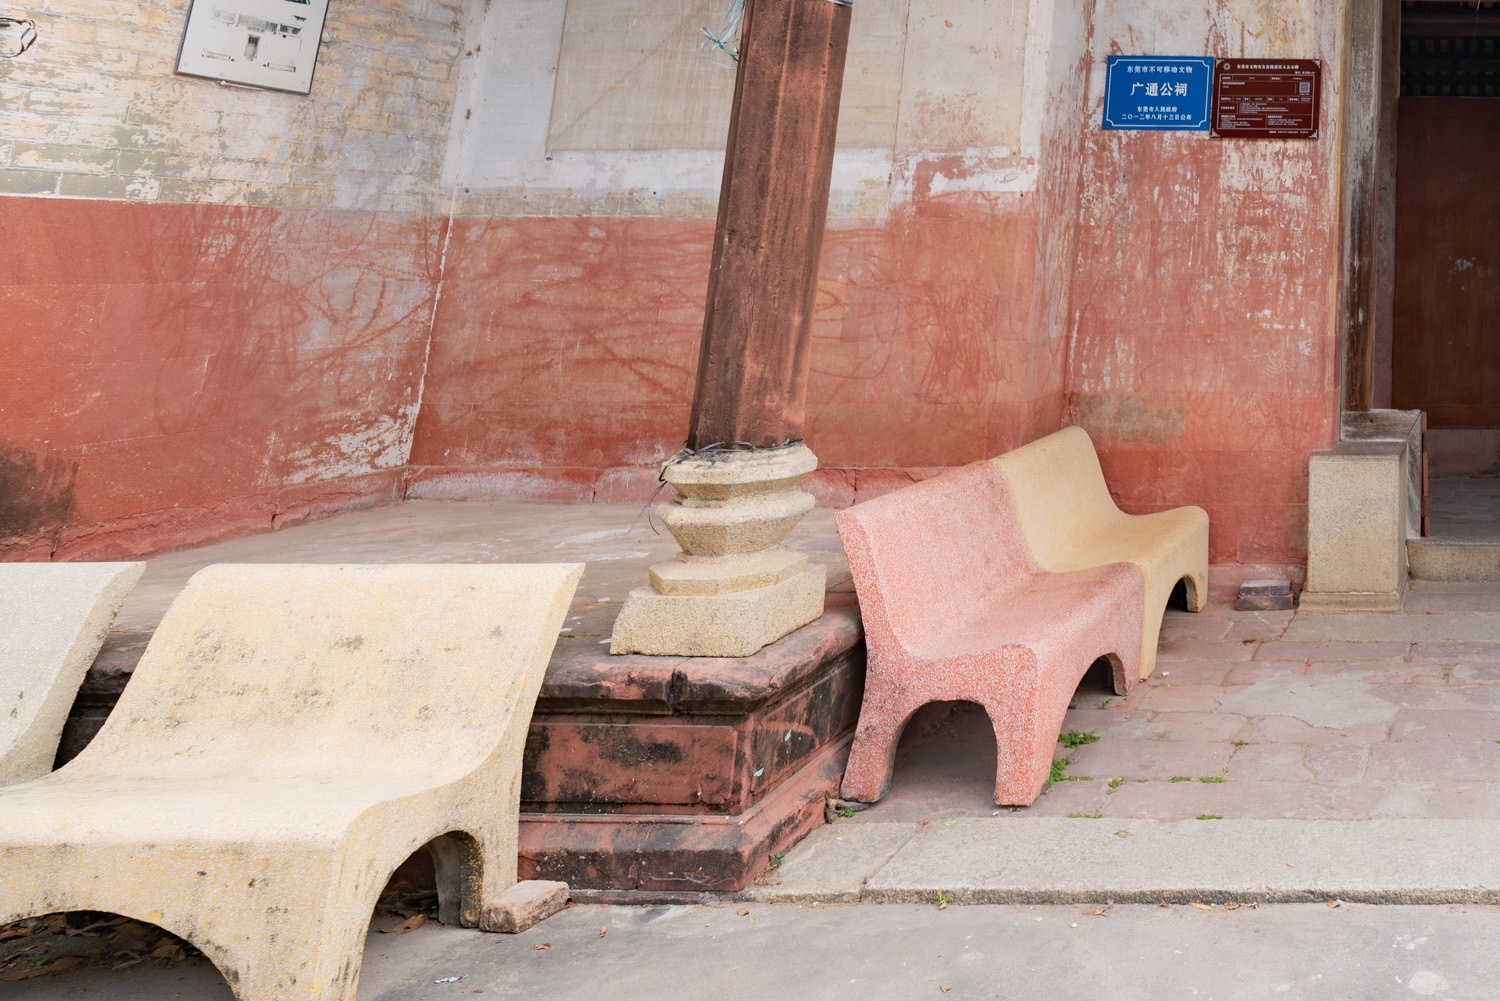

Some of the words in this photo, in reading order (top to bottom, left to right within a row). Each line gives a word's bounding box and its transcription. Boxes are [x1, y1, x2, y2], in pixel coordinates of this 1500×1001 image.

[1126, 65, 1193, 74] 东莞市不可移动文物
[1130, 82, 1188, 97] 广通公祠
